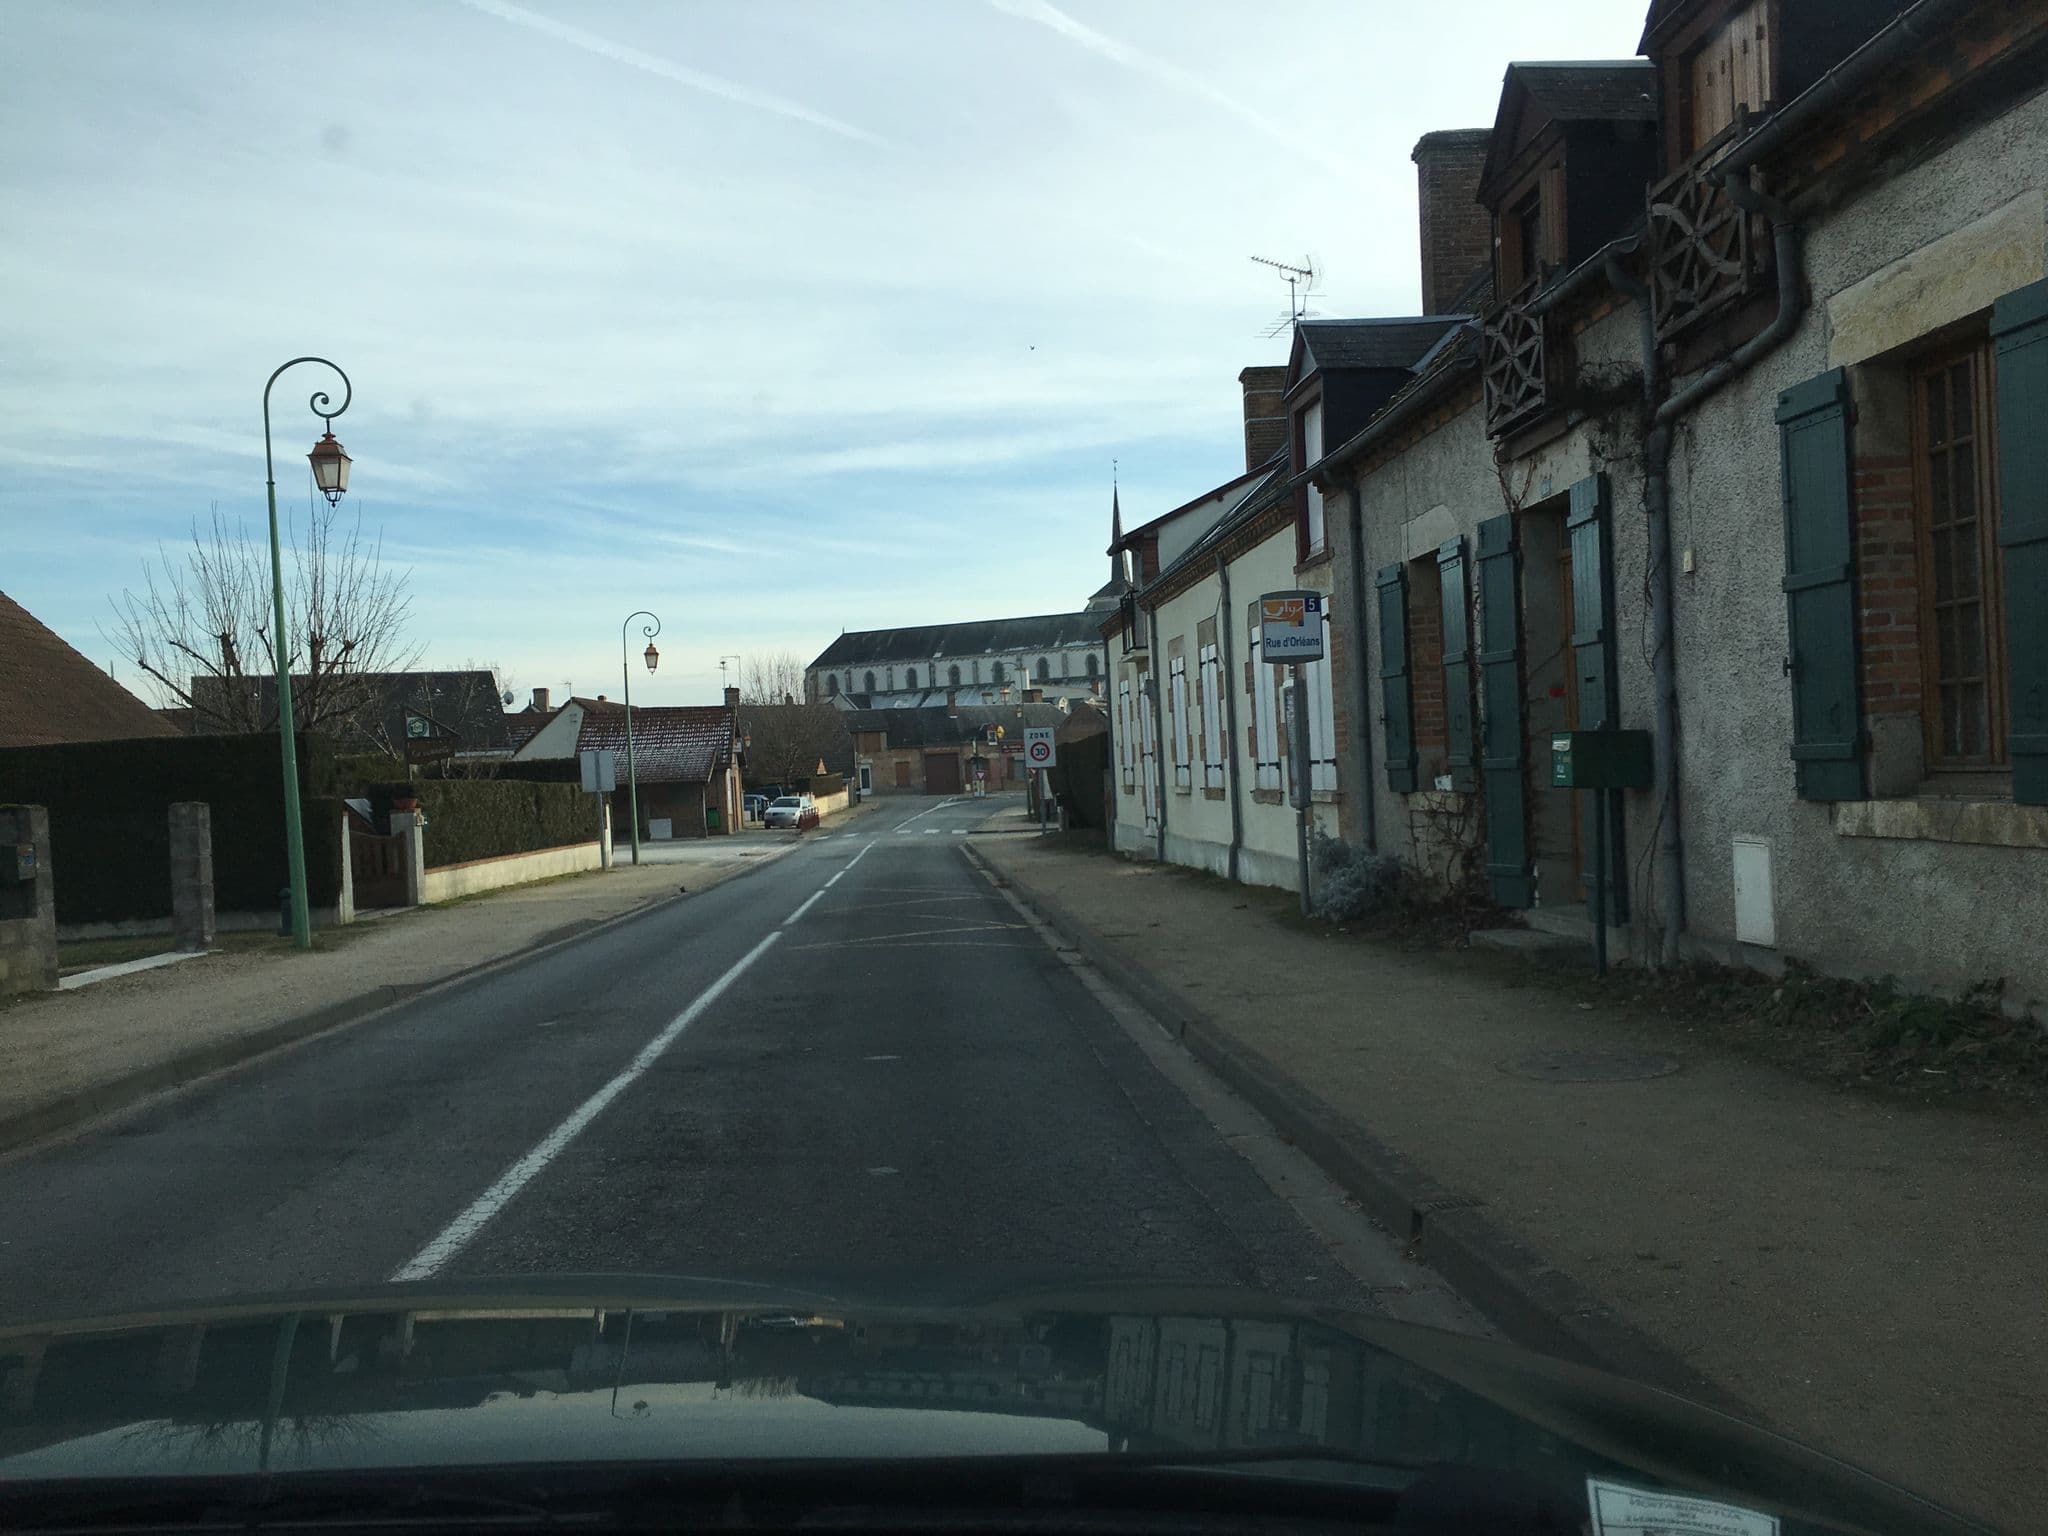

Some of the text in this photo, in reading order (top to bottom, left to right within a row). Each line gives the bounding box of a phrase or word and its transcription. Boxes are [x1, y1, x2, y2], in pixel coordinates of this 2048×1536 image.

[1308, 598, 1316, 611] 5
[1265, 636, 1320, 648] Rue d'Orléans
[1034, 748, 1046, 756] 30
